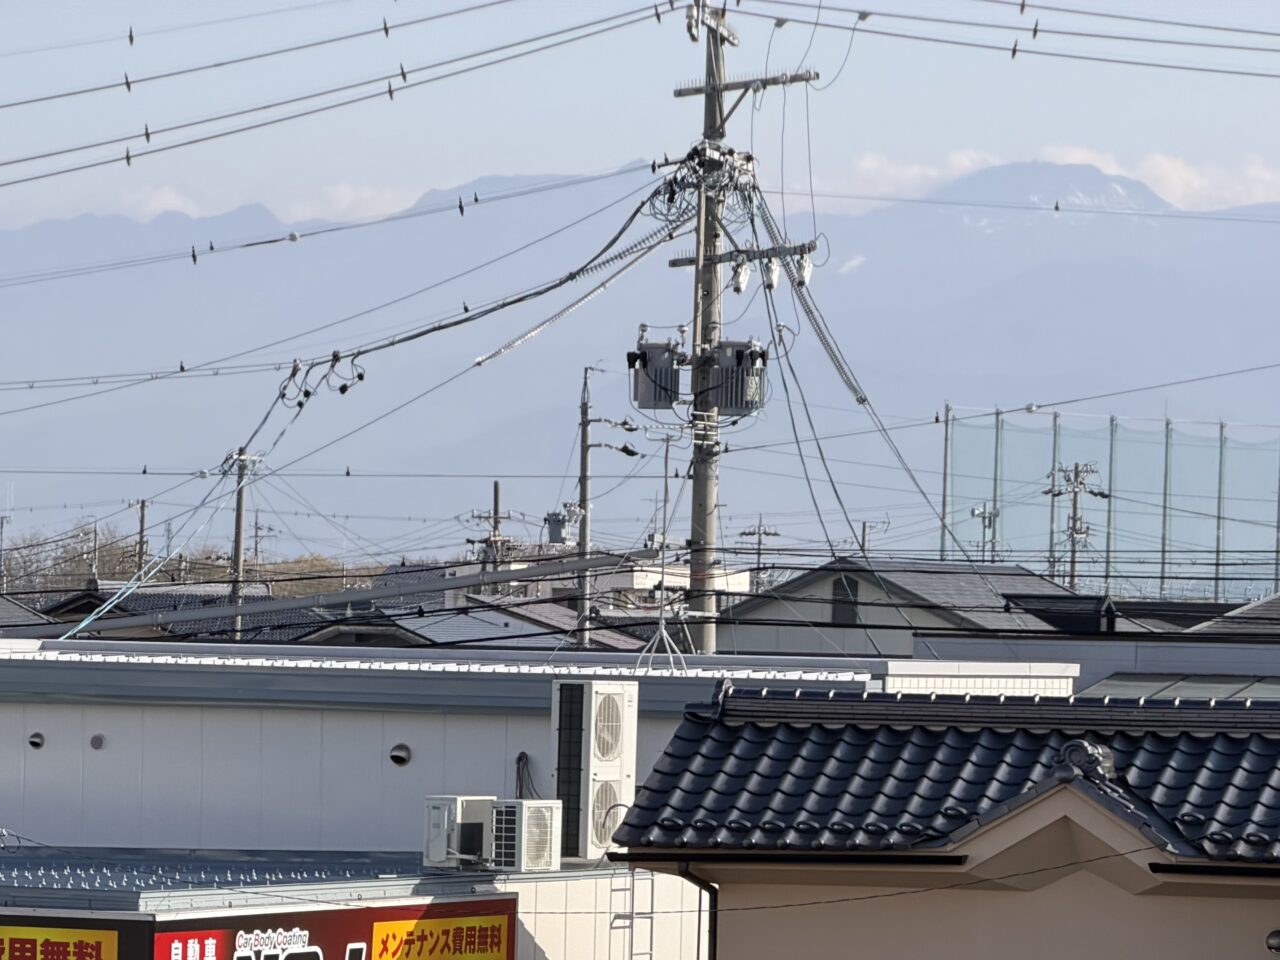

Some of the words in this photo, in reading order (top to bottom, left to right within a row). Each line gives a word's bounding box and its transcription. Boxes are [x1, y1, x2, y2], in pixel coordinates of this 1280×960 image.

[236, 930, 253, 950] Car
[253, 929, 276, 950] Body
[276, 927, 309, 949] Coating
[378, 924, 502, 960] メンテナンス費用無料
